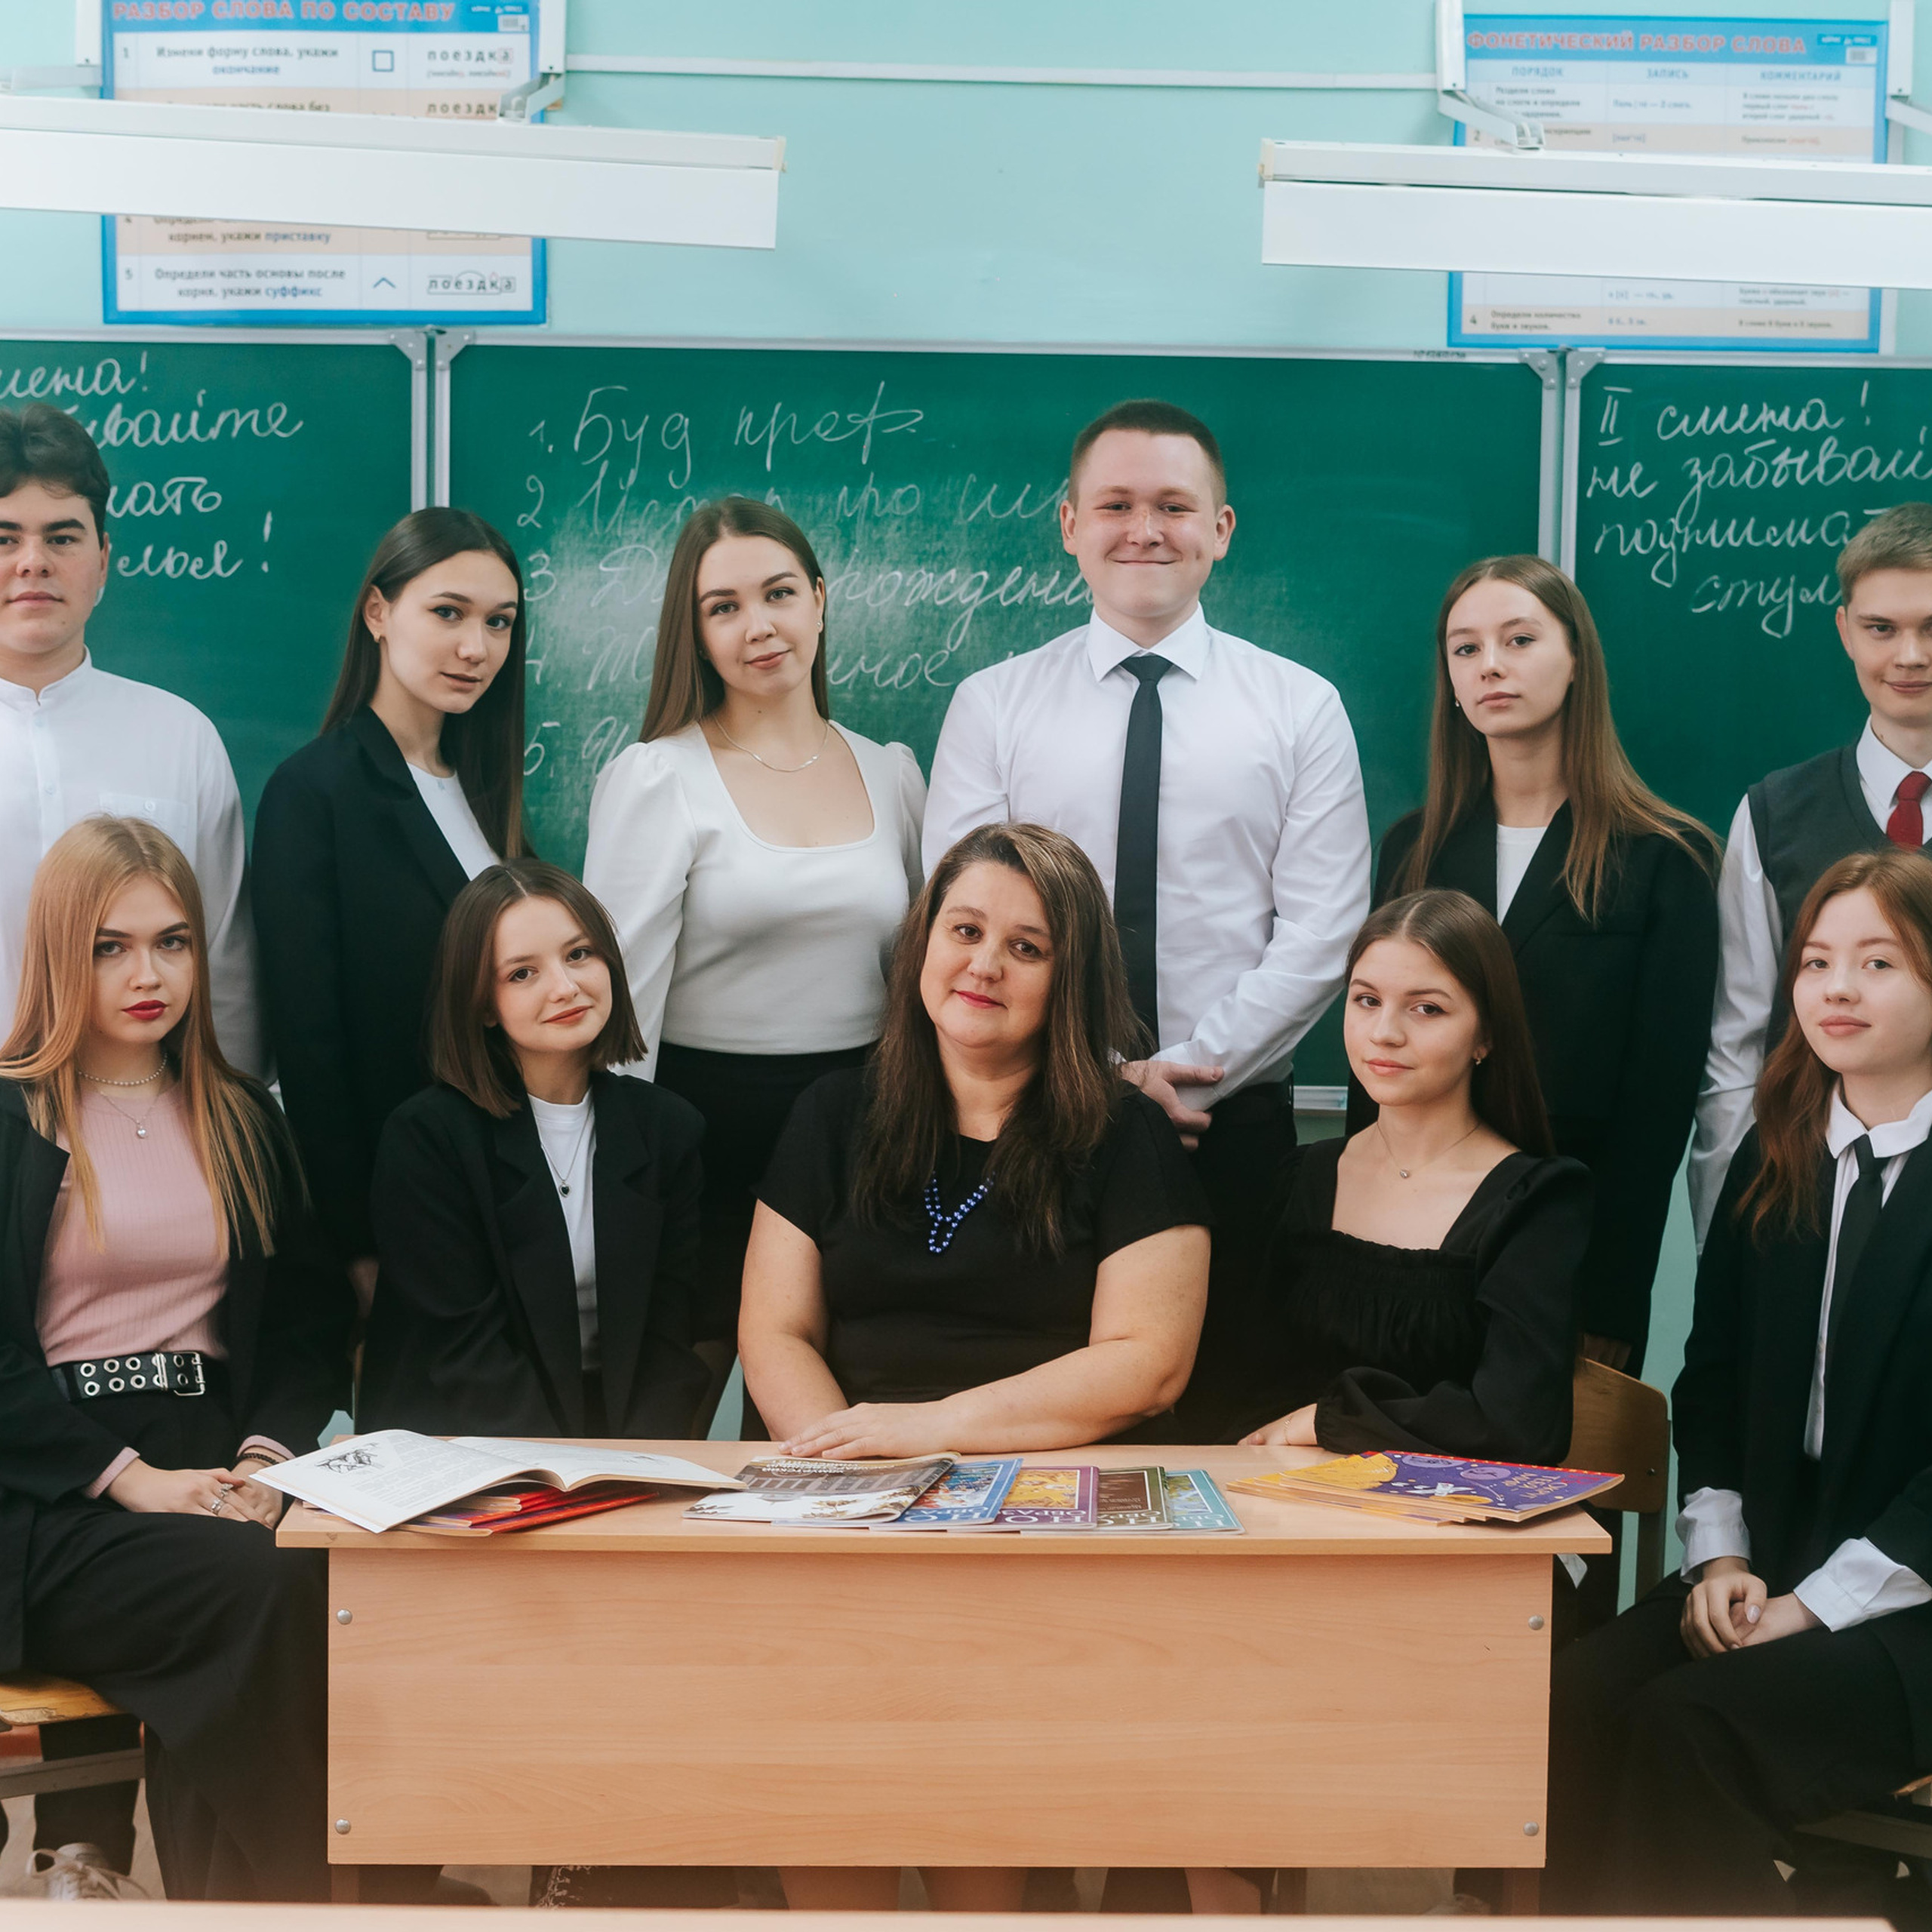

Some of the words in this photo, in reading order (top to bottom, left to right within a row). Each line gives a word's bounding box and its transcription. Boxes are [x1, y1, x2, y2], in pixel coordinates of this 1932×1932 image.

[113, 1, 205, 20] РАЗБОР
[212, 1, 294, 19] СЛОВА
[302, 2, 336, 20] ПО
[343, 2, 455, 21] СОСТАВУ
[1467, 30, 1634, 50] ФОНЕТИЧЕСКИЙ
[1640, 34, 1725, 52] РАЗБОР
[1731, 36, 1807, 54] СЛОВА
[1511, 66, 1563, 77] ПОРЯДОК
[1760, 70, 1841, 82] КОММЕНТАРИЙ
[265, 285, 323, 300] суффикс
[574, 385, 692, 490] Буд
[1586, 461, 1659, 499] не
[516, 475, 543, 528] 2
